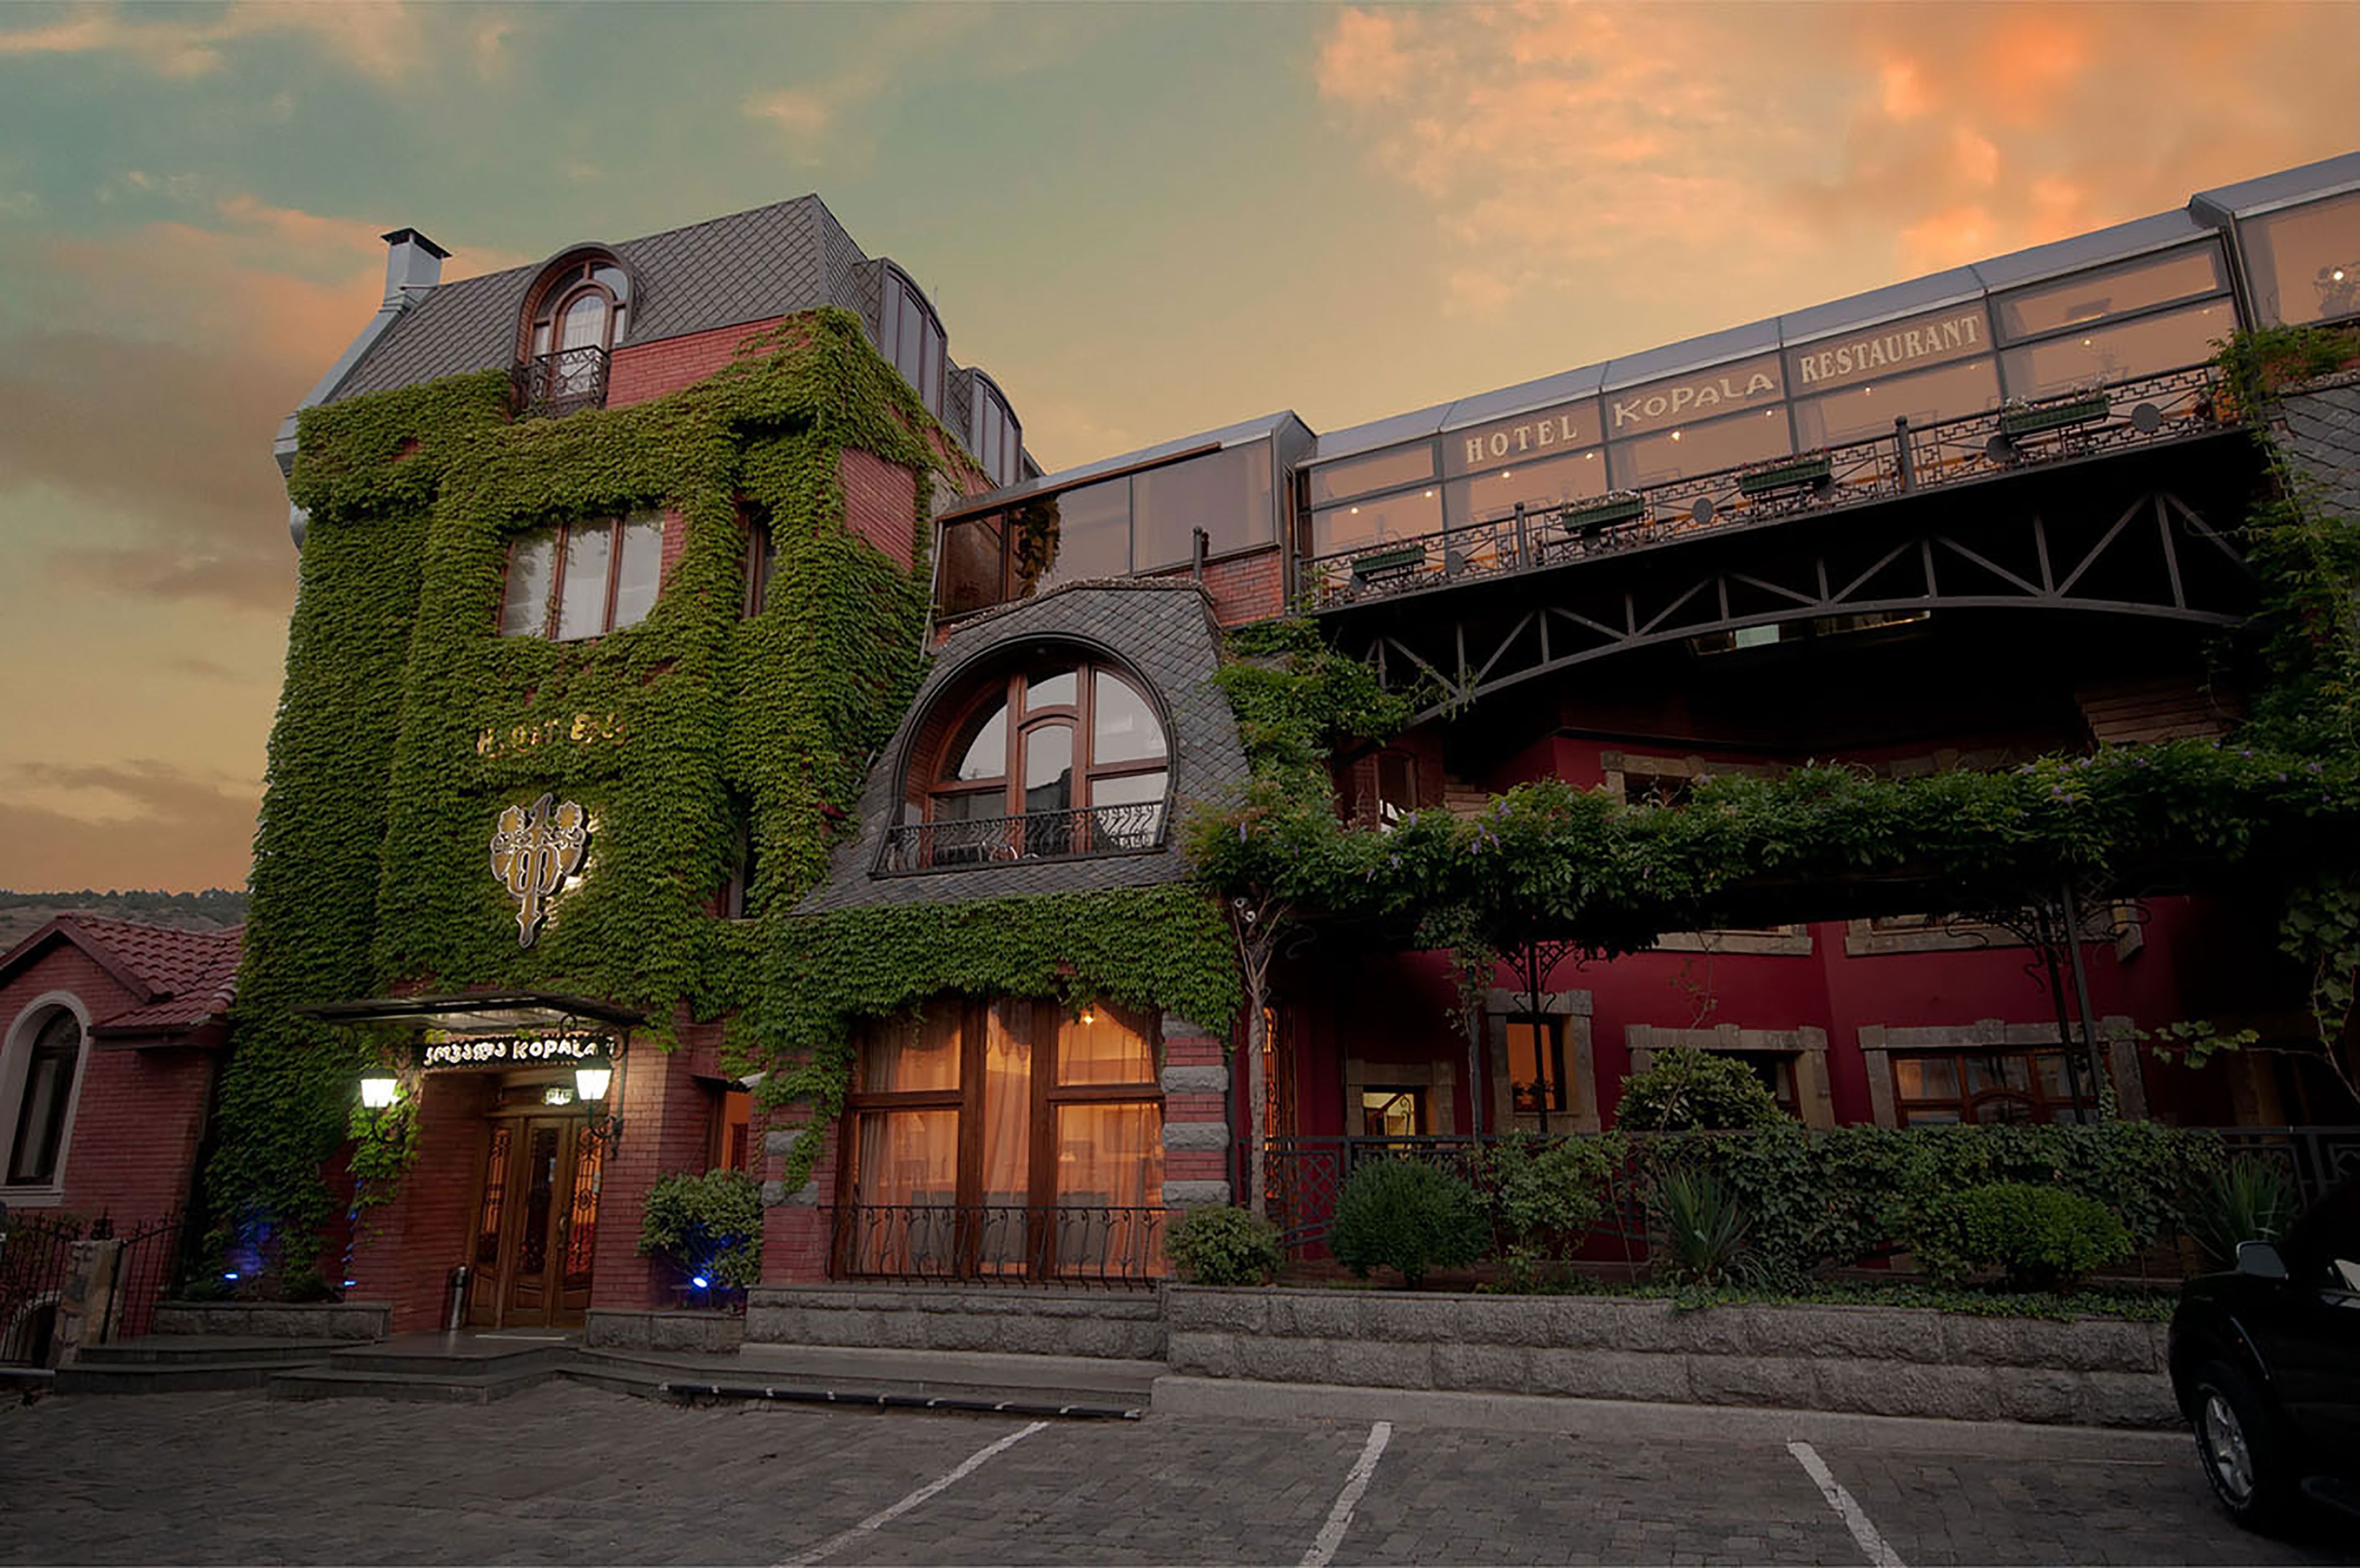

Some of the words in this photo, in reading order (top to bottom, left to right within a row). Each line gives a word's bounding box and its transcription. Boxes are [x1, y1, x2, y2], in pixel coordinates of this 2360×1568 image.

[1465, 416, 1578, 465] HOTEL
[1613, 372, 1776, 428] KOPALA
[1799, 315, 1981, 385] RESTAURANT
[512, 1038, 599, 1060] KOPALA
